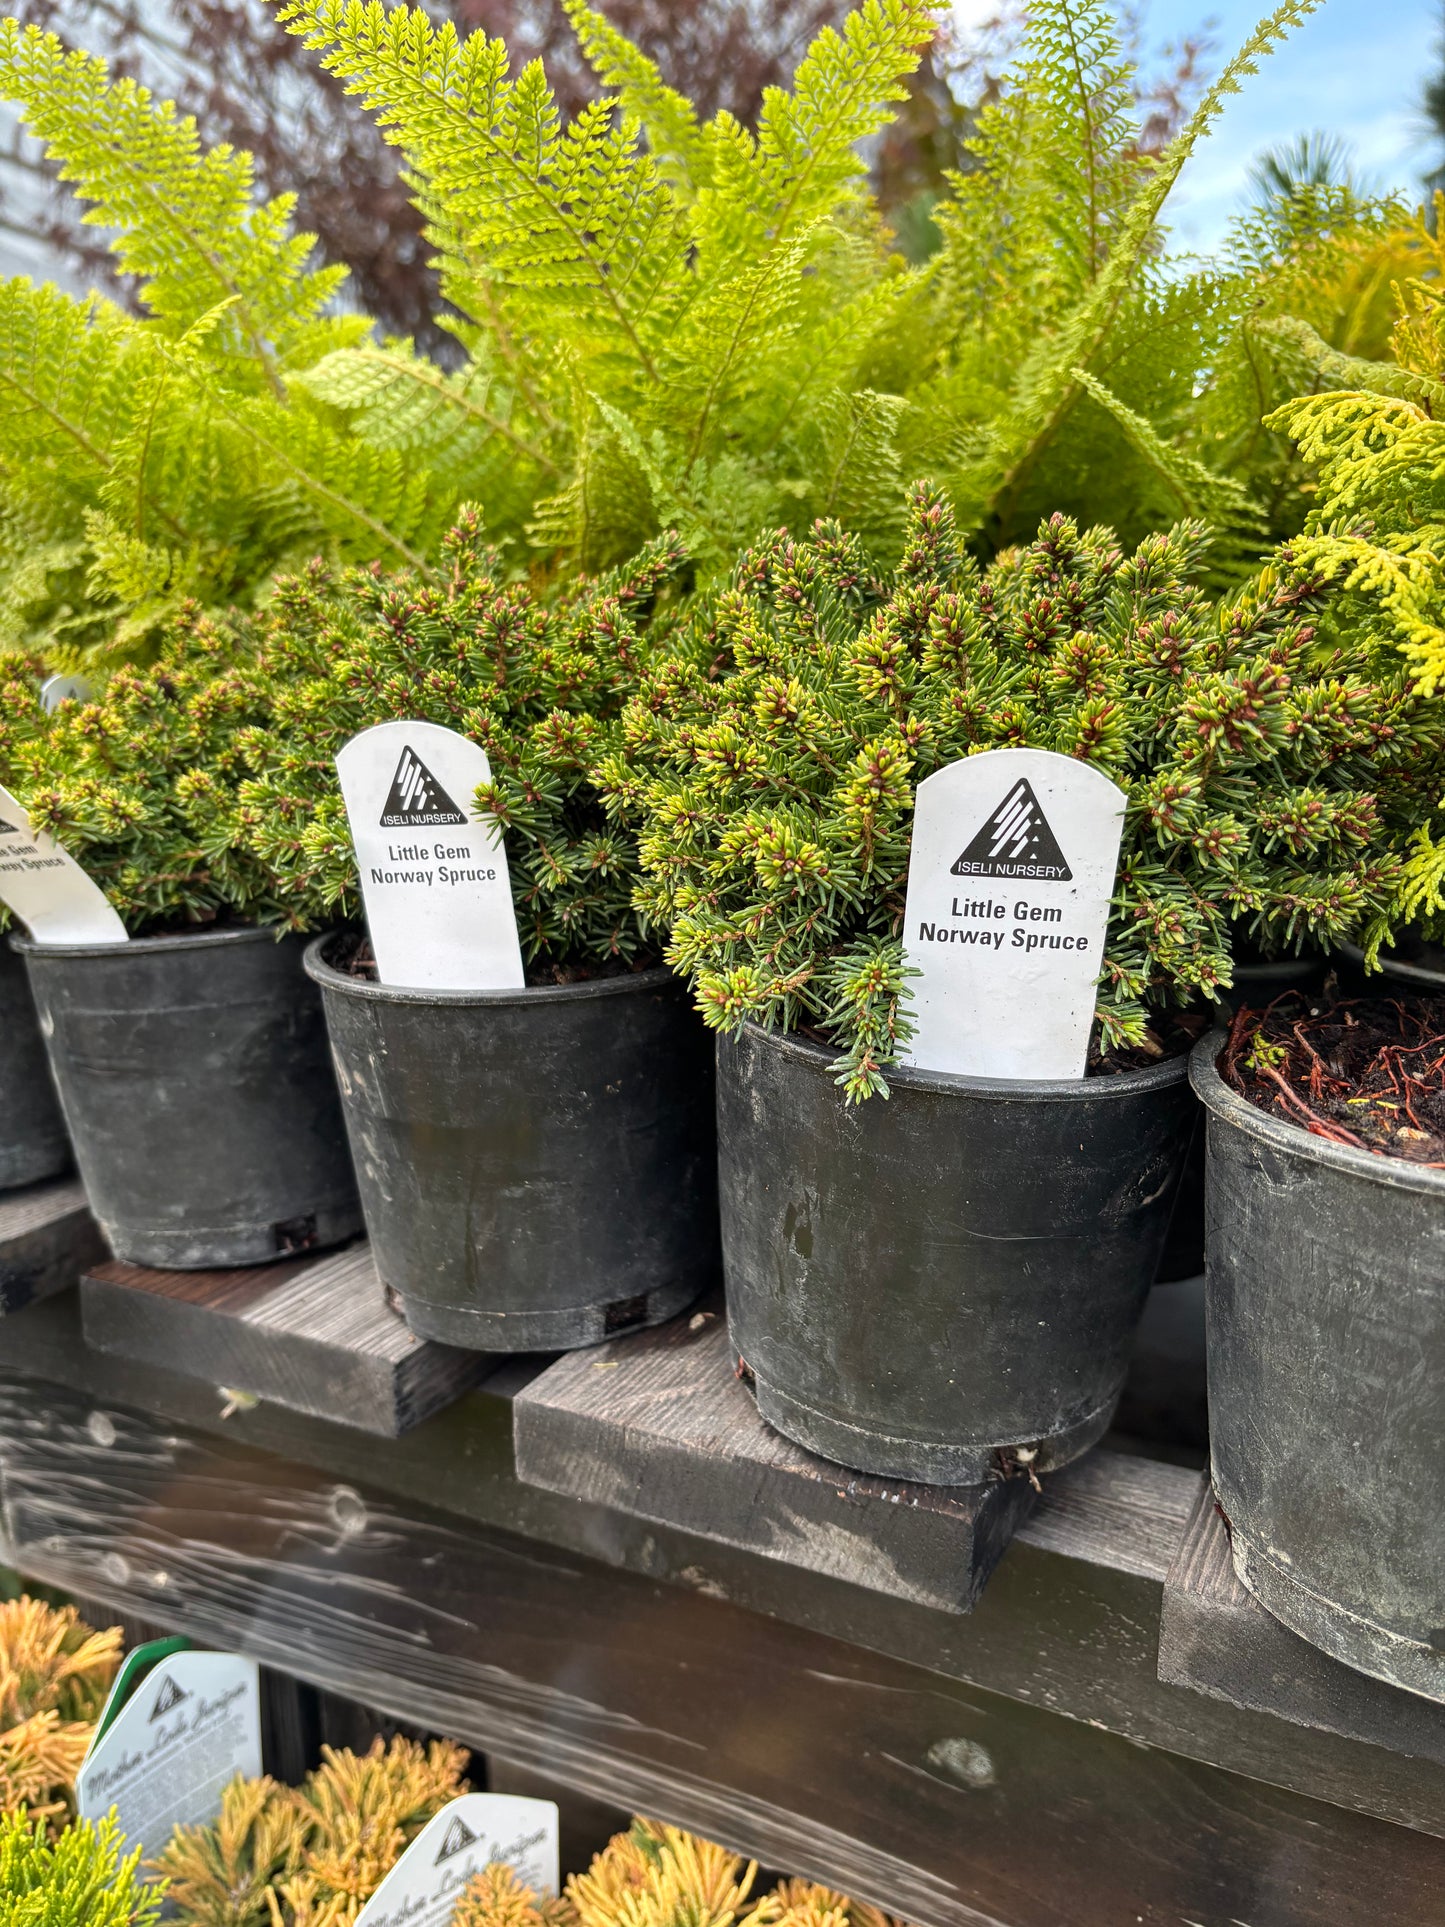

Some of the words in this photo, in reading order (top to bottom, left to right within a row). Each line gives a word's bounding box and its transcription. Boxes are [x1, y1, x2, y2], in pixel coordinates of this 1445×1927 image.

[383, 814, 409, 825] ISELI
[411, 813, 462, 825] NURSERY
[388, 844, 430, 861] Little
[433, 843, 471, 860] Gem
[370, 867, 434, 887] Norway
[438, 865, 497, 886] Spruce
[957, 861, 992, 874] ISELI
[995, 863, 1066, 878] NURSERY
[951, 897, 1006, 919] Little
[1013, 900, 1062, 922] Gem
[918, 922, 1006, 950] Norway
[1010, 927, 1089, 953] Spruce
